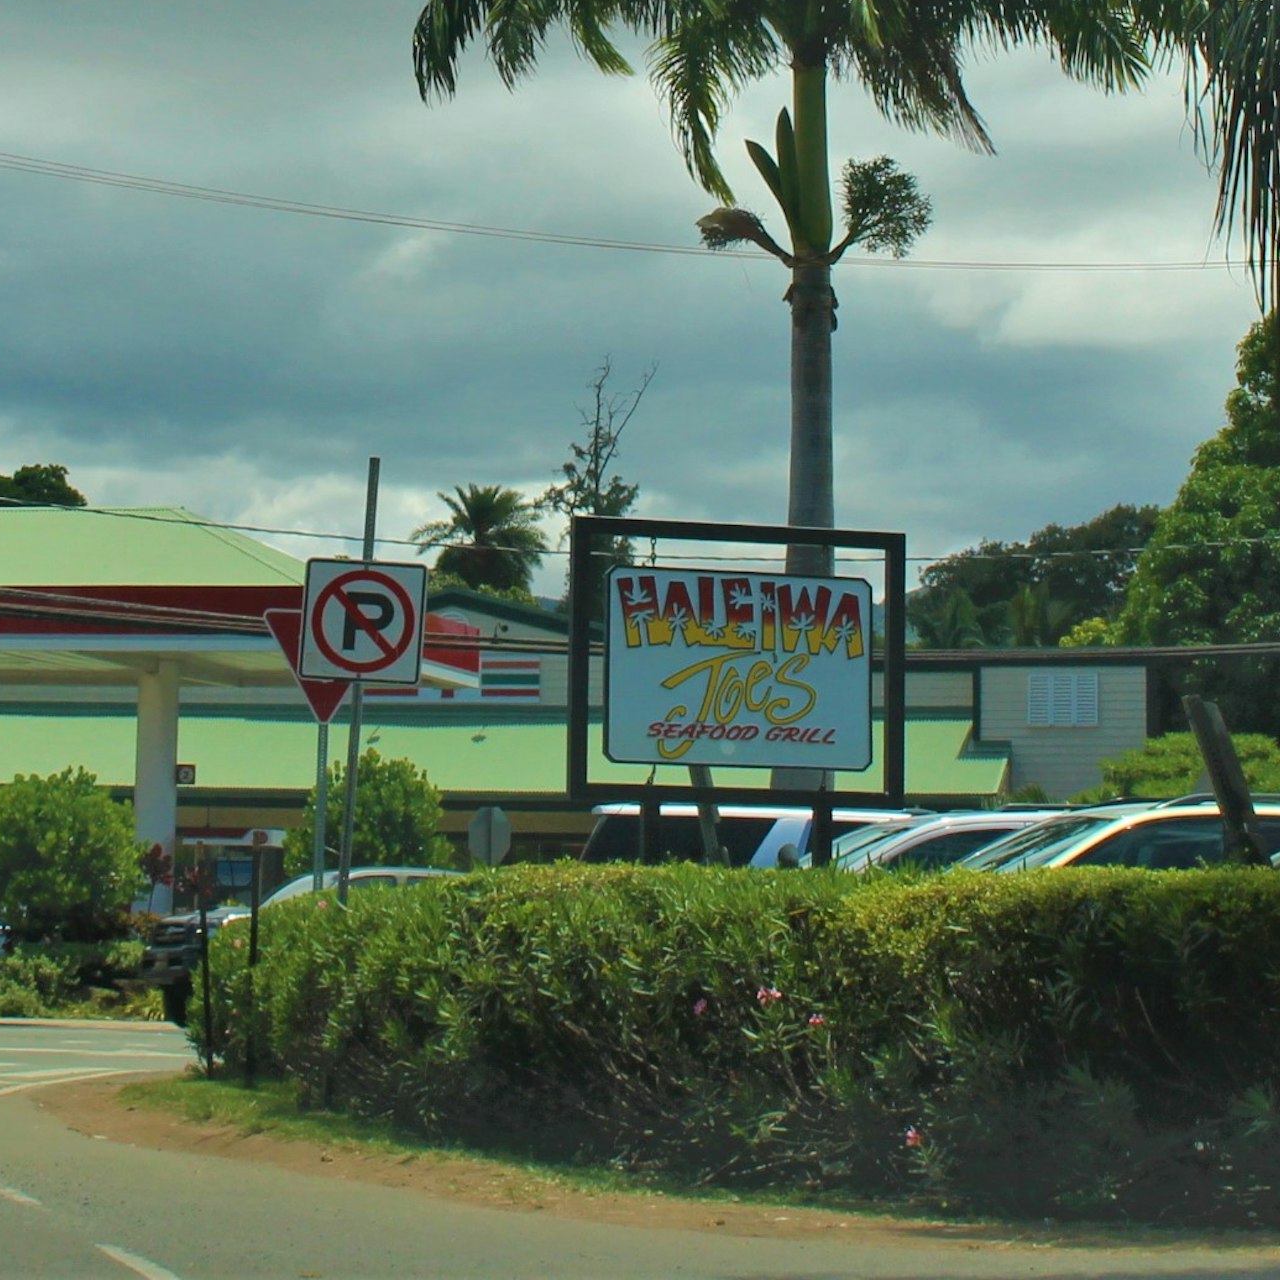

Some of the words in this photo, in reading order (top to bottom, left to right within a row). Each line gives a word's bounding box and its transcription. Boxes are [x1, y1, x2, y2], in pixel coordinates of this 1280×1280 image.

[342, 592, 395, 650] P
[616, 575, 865, 660] HALEIWA
[647, 722, 759, 741] SEAFOOD
[765, 726, 836, 745] GRILL
